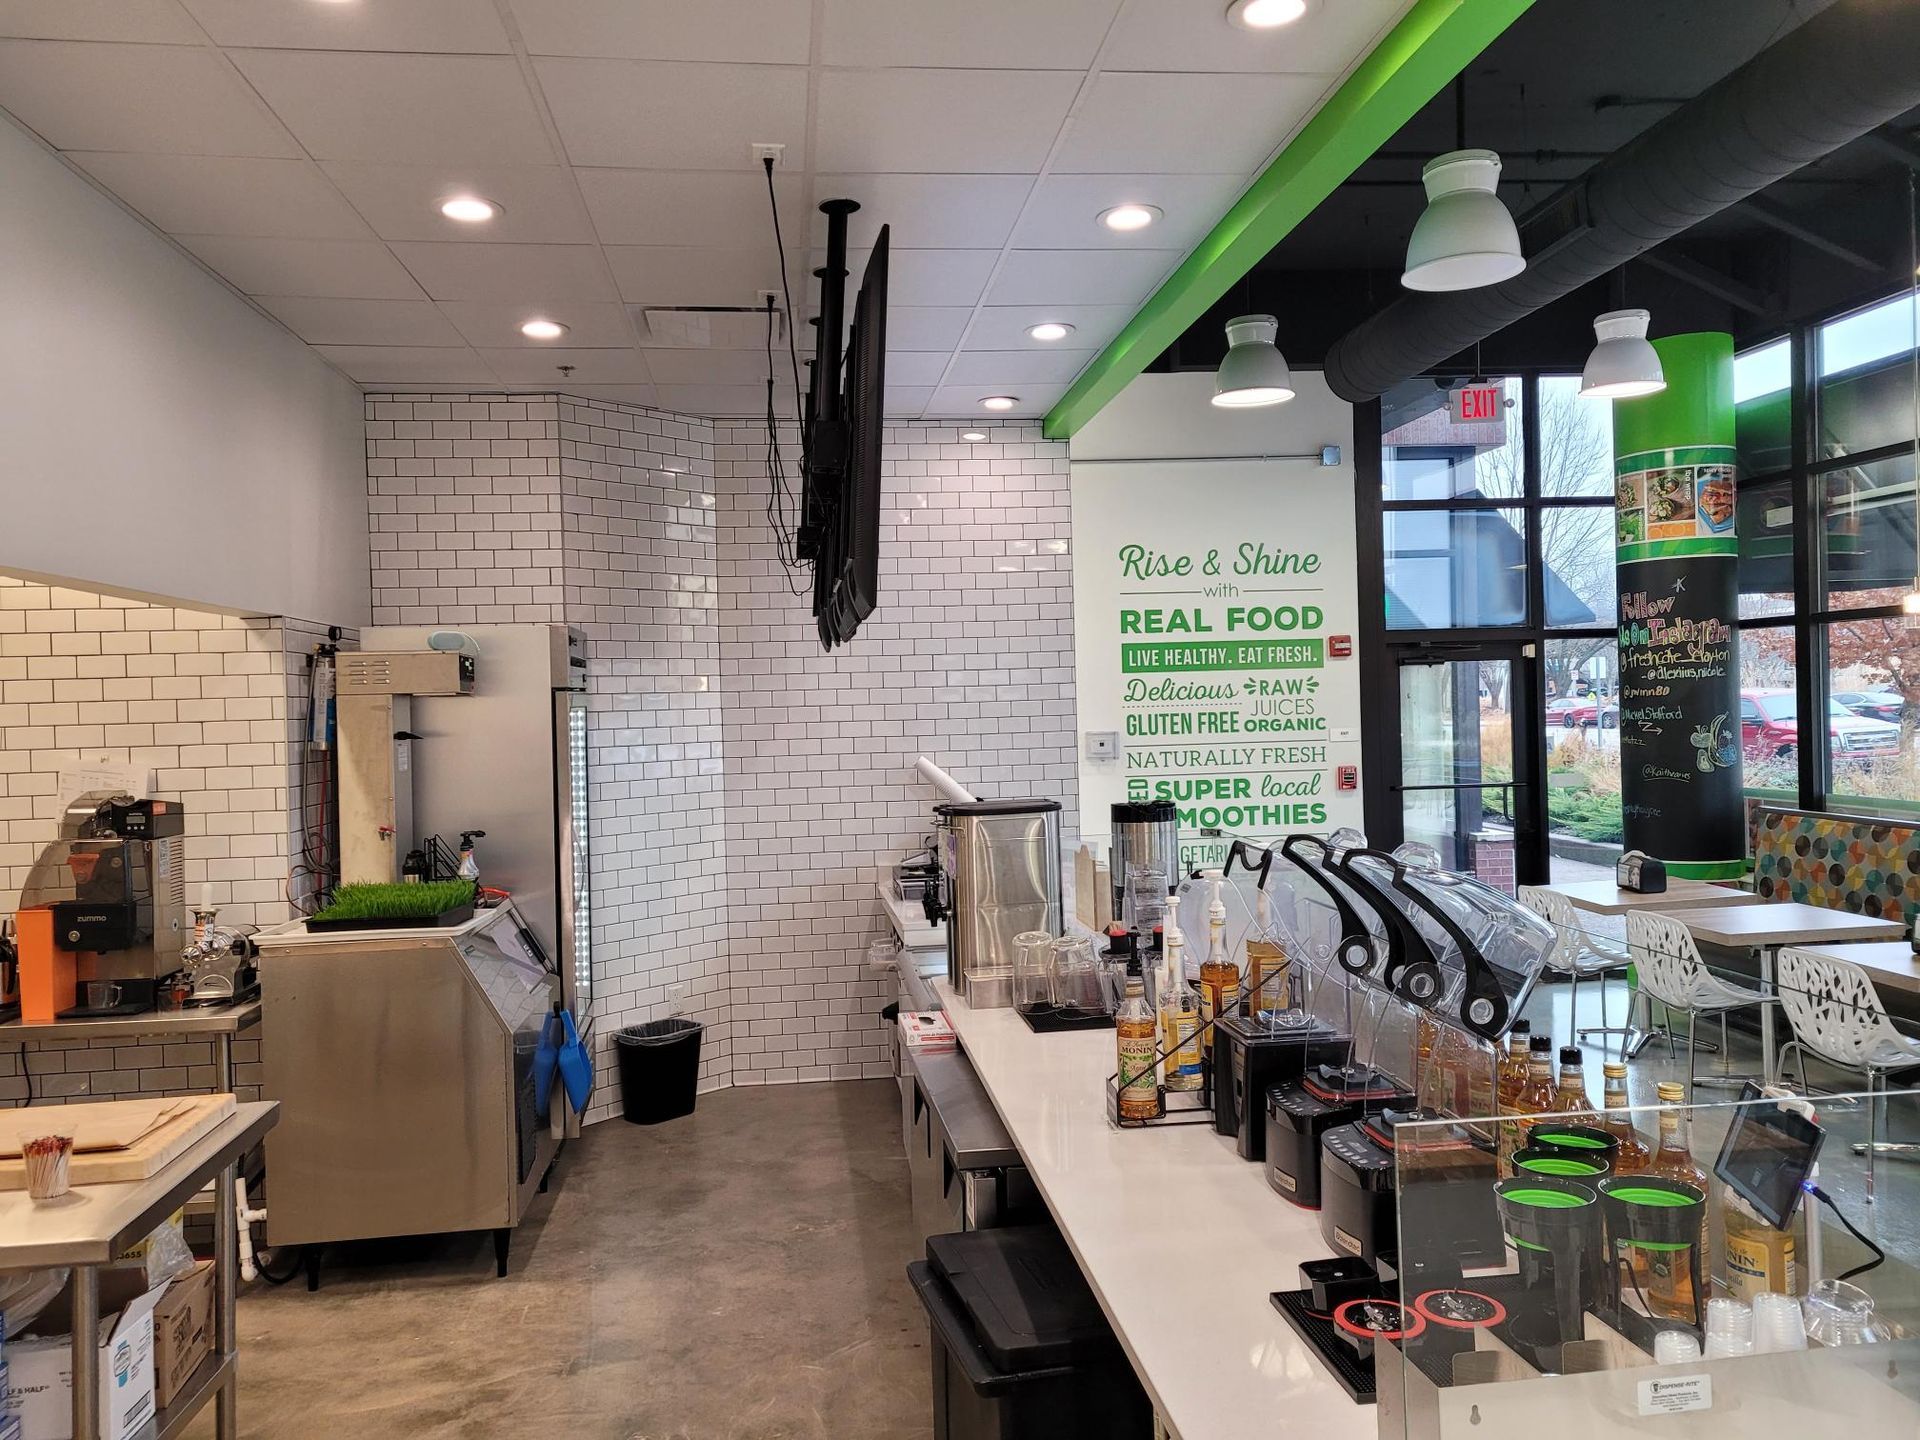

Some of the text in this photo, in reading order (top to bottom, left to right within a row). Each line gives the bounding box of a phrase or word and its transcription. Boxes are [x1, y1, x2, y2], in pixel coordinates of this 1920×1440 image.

[1462, 390, 1496, 418] EXIT
[1119, 542, 1322, 581] Rise & Shine
[1203, 583, 1239, 598] with
[1621, 591, 1676, 622] Follow
[1120, 606, 1324, 634] REAL FOOD
[1128, 646, 1318, 667] LIVE HEALTHY. EAT FRESH.
[1123, 677, 1240, 702] Delicious
[1259, 678, 1303, 696] RAW
[1250, 698, 1315, 716] JUICES
[1126, 711, 1240, 737] GLUTEN FREE
[1244, 717, 1327, 733] ORGANIC
[1127, 746, 1327, 769] NATURALLY FRESH
[1155, 778, 1251, 801] SUPER
[1261, 772, 1322, 797] local
[1177, 802, 1328, 829] MOOTHIES
[1180, 844, 1229, 866] GETARI
[1121, 1046, 1154, 1054] MONIN
[1728, 1249, 1756, 1267] NIN
[25, 1386, 46, 1394] HALF
